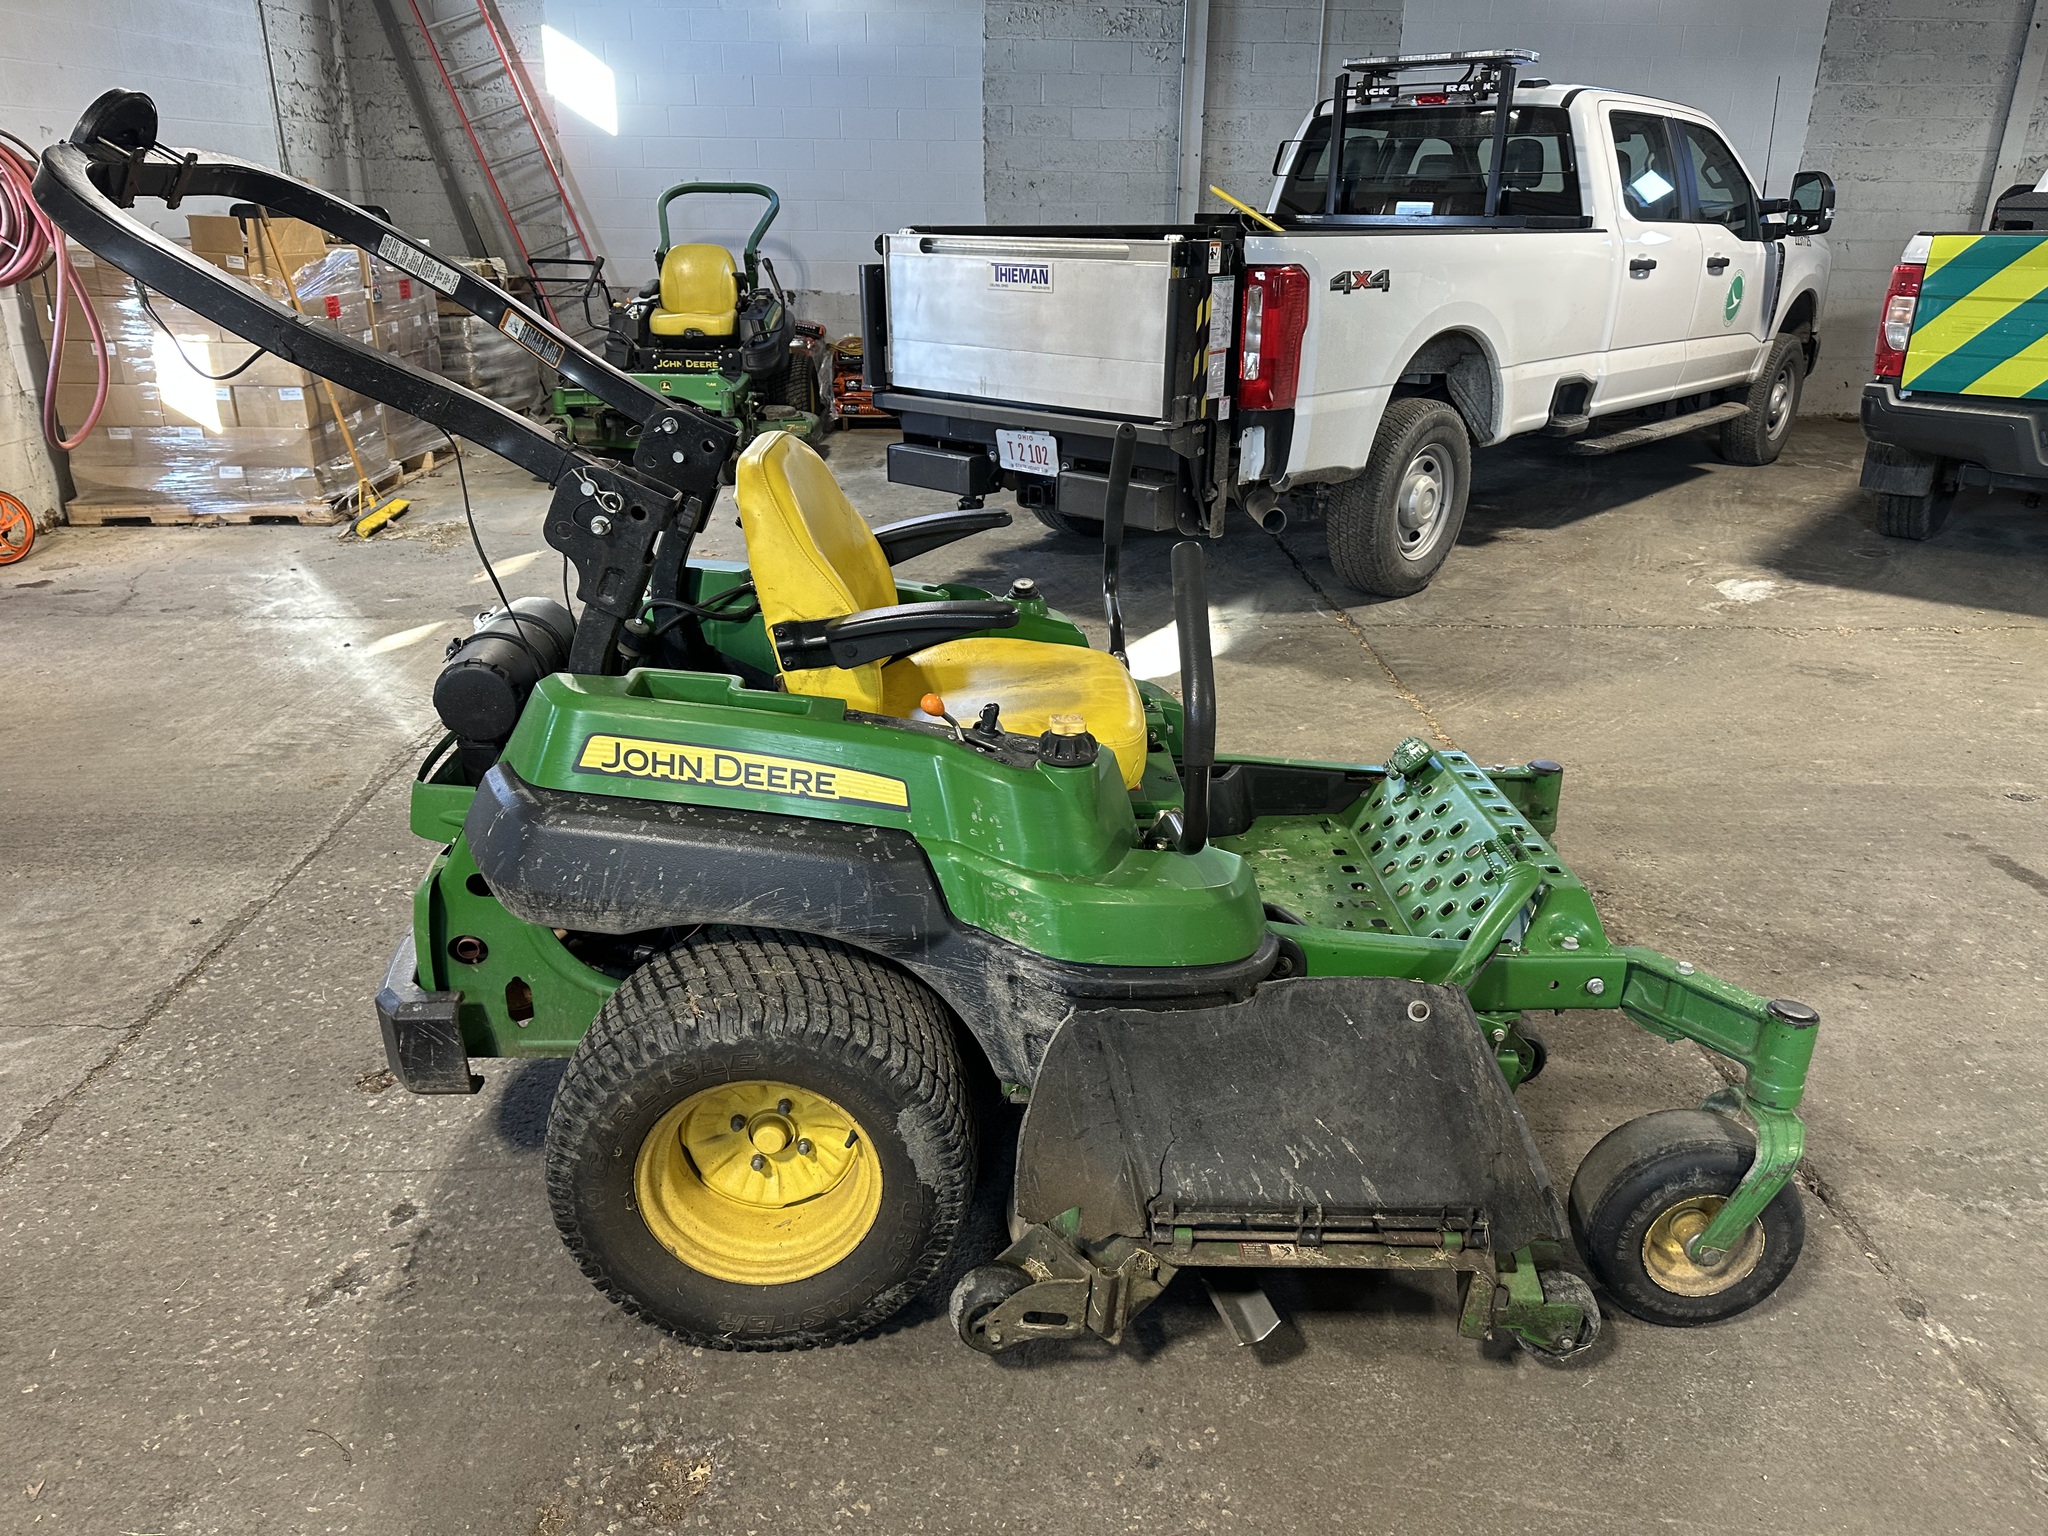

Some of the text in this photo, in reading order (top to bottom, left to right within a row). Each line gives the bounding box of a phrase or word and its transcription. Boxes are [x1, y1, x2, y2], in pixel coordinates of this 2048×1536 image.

[1346, 87, 1391, 97] BCK
[991, 263, 1048, 284] THIEMAN
[657, 359, 719, 368] JOHN DEERE
[1017, 433, 1034, 442] OHIO
[601, 742, 836, 795] JOHN DEERE
[586, 1052, 762, 1179] CARLISLE
